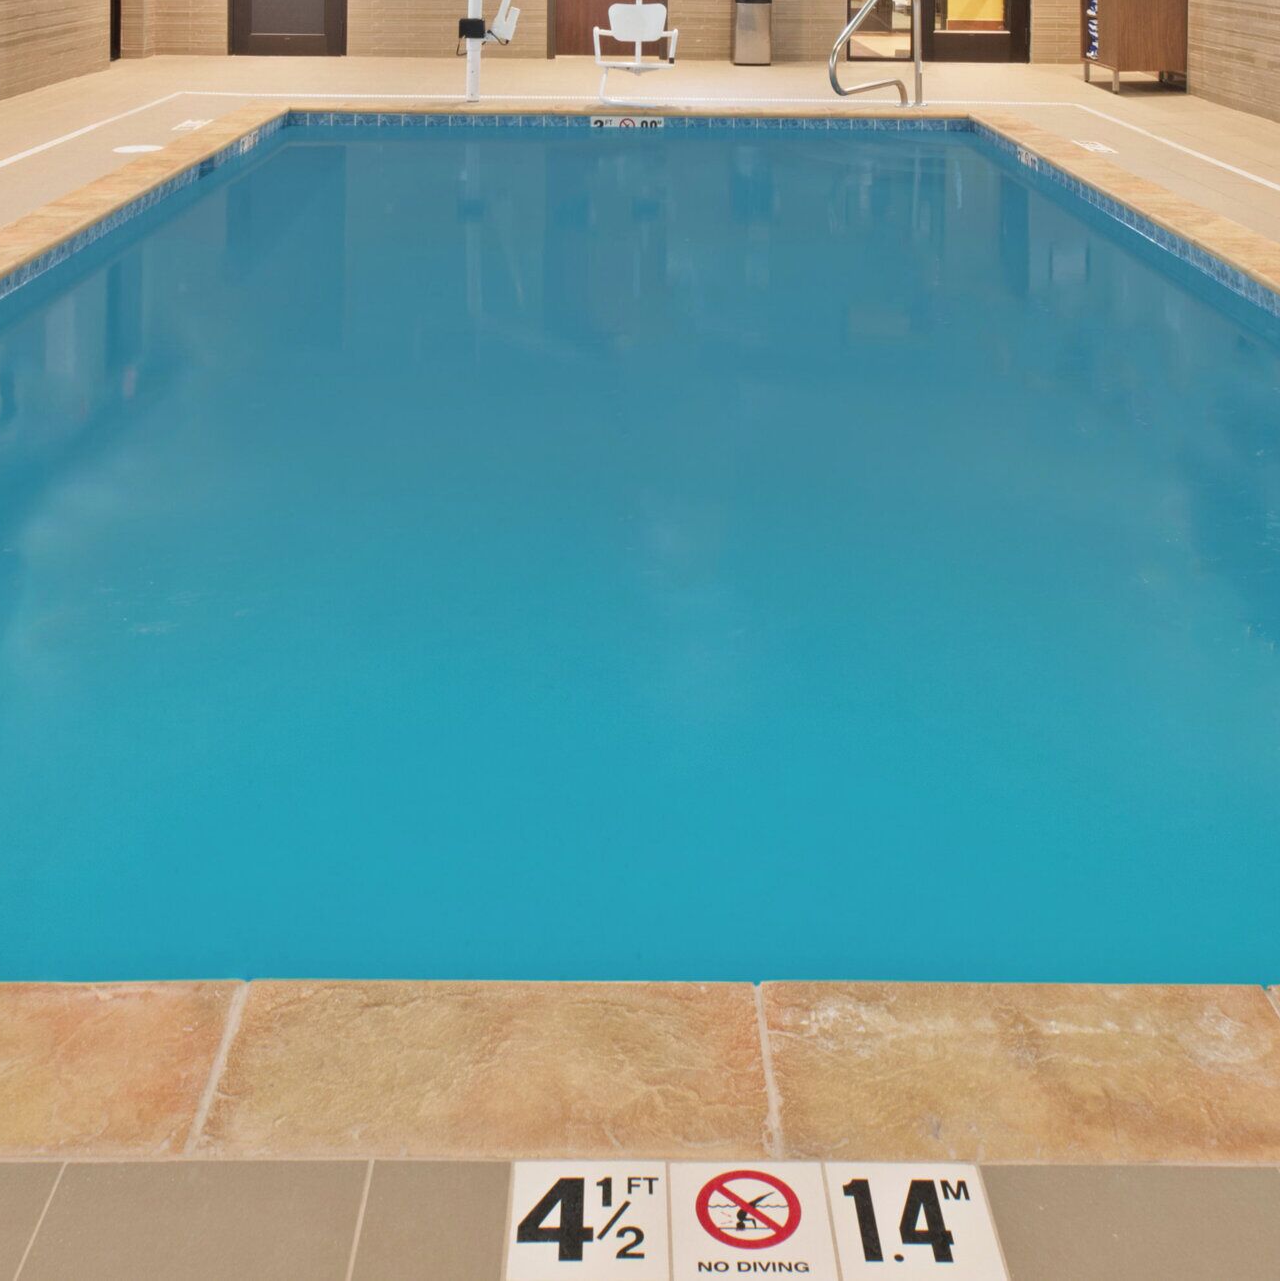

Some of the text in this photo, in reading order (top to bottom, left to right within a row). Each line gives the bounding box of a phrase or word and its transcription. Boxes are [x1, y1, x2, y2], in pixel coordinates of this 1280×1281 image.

[627, 1177, 659, 1195] FT
[940, 1180, 970, 1200] M
[698, 1261, 810, 1273] NO DIVING
